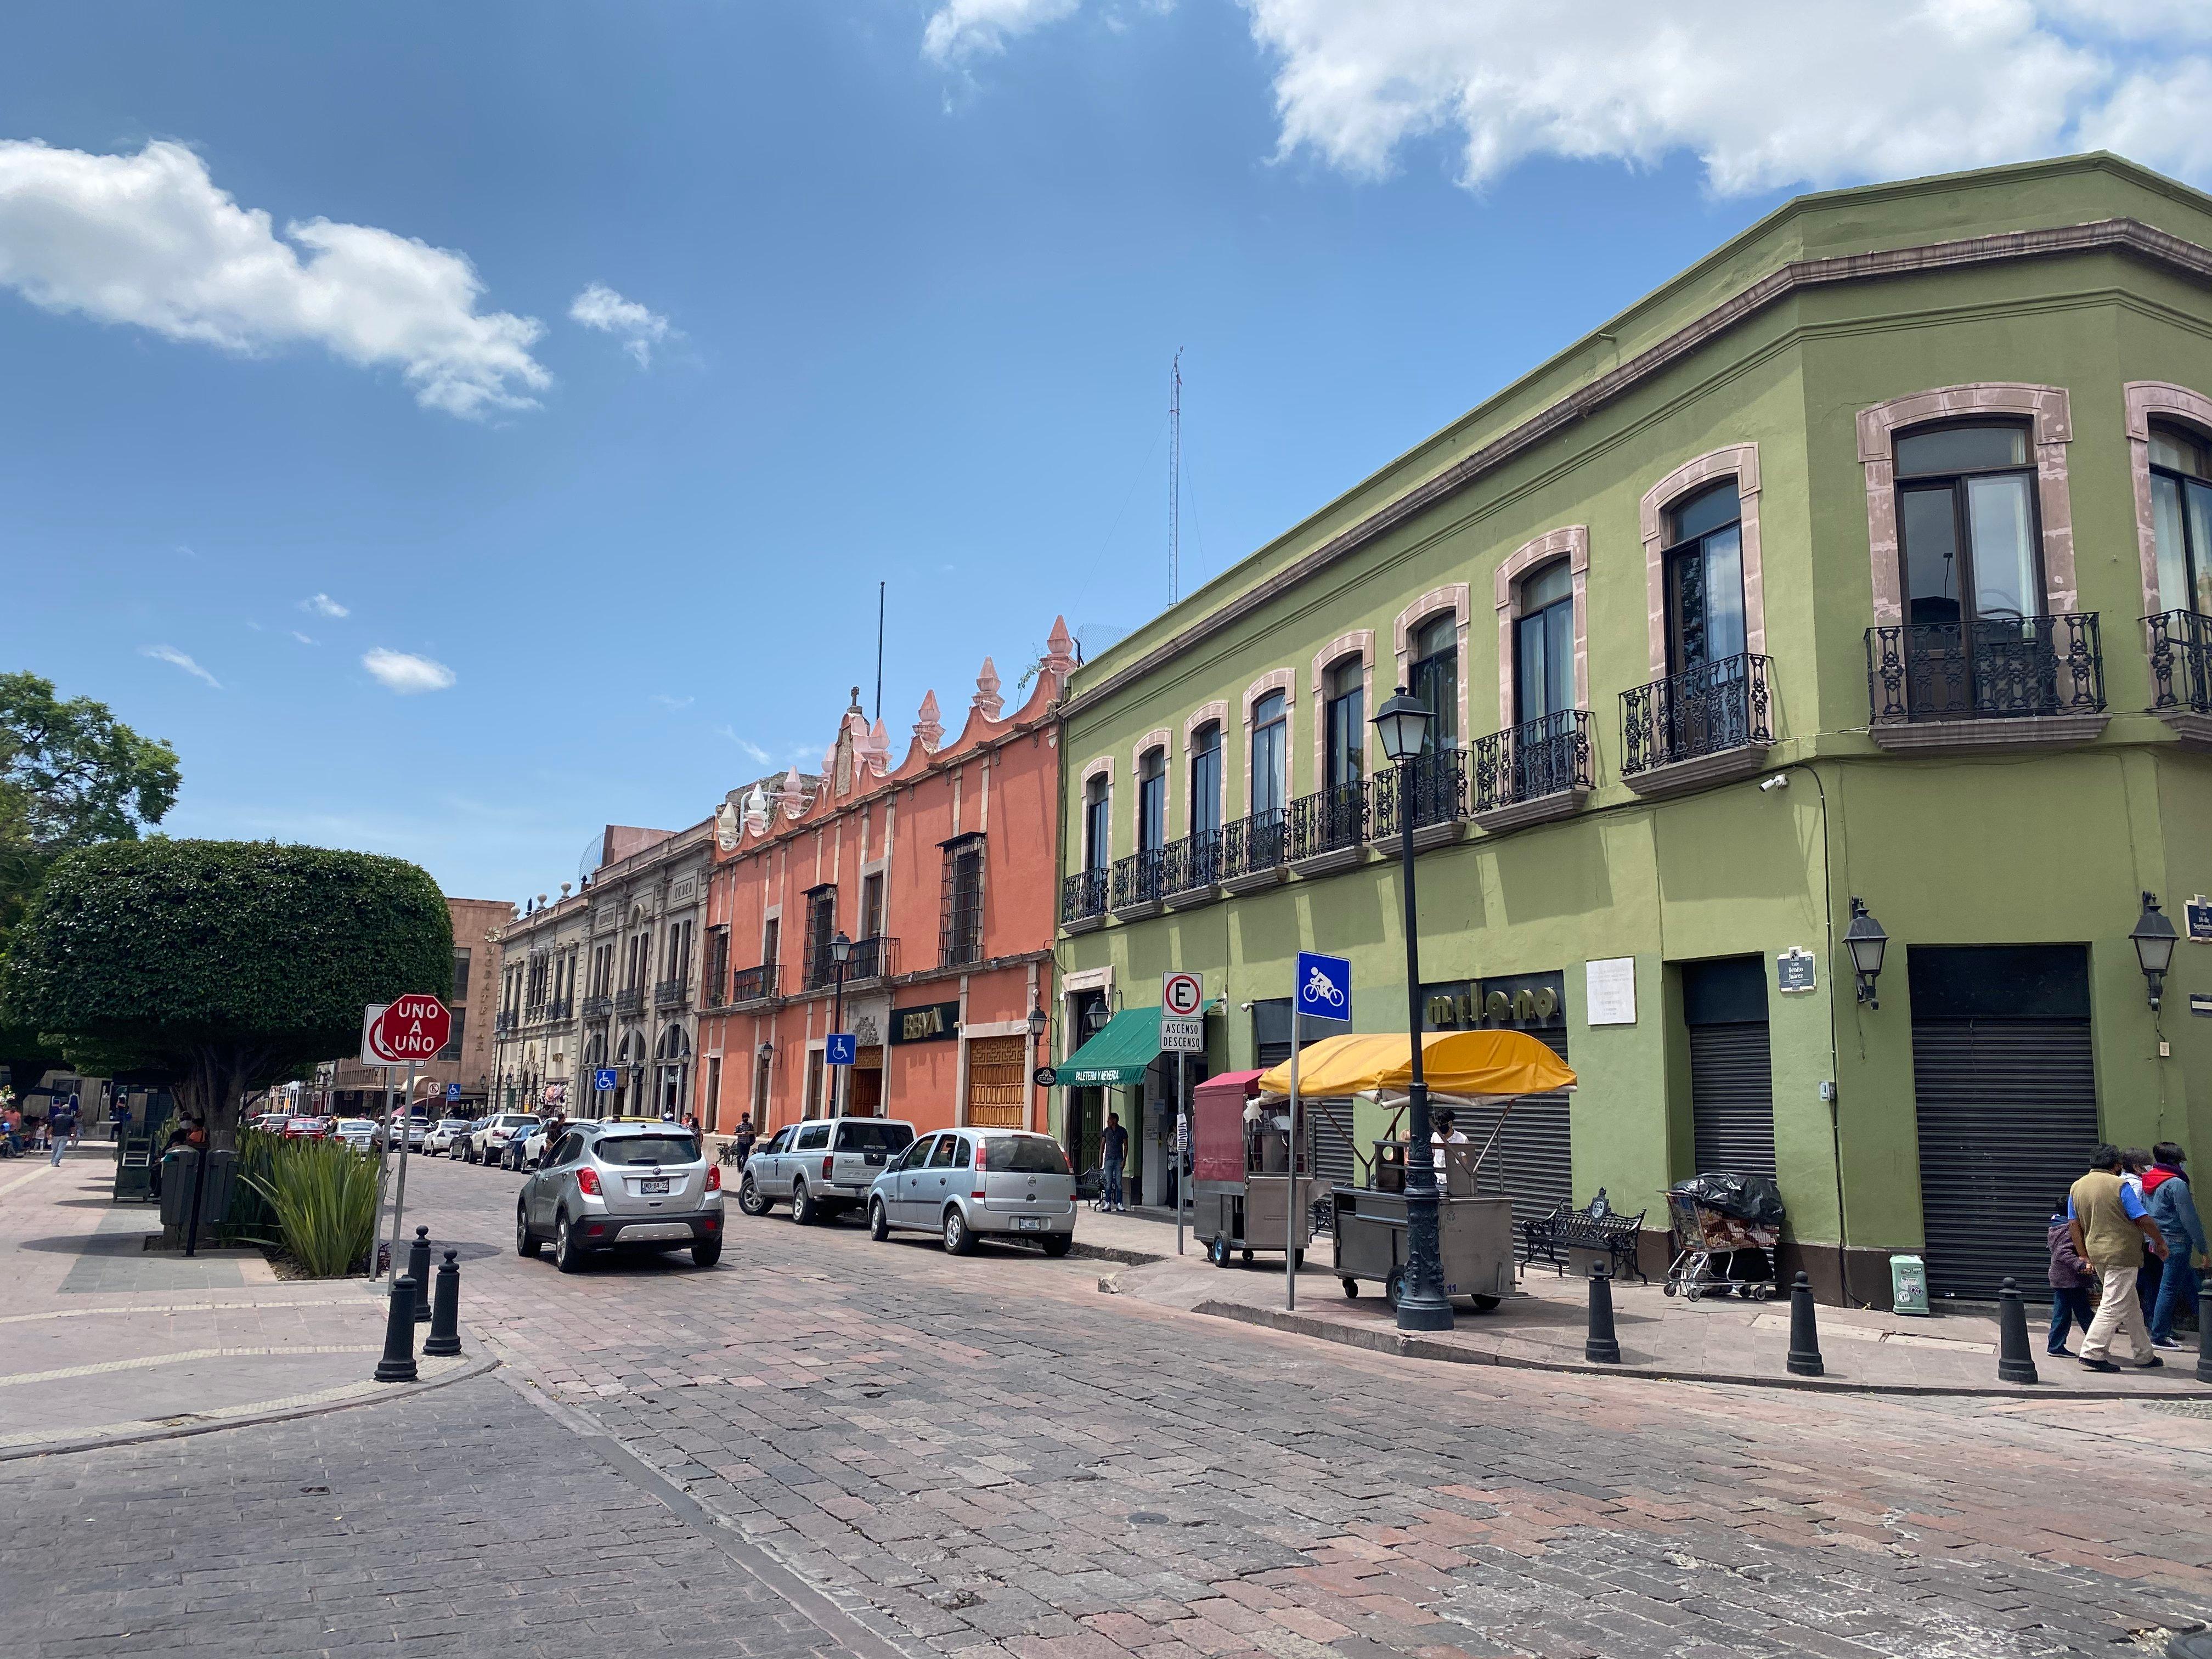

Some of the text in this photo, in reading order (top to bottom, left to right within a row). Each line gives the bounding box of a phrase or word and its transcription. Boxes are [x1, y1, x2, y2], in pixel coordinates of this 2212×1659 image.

[1176, 983, 1190, 1007] E
[398, 1003, 438, 1019] UNO
[409, 1020, 422, 1035] A
[903, 1007, 944, 1040] BBVA
[1166, 1024, 1198, 1035] ASCENSO
[394, 1036, 435, 1052] UNO
[1163, 1037, 1200, 1048] DESCENSO
[1097, 1070, 1101, 1081] Y
[1447, 1284, 1457, 1293] 11
